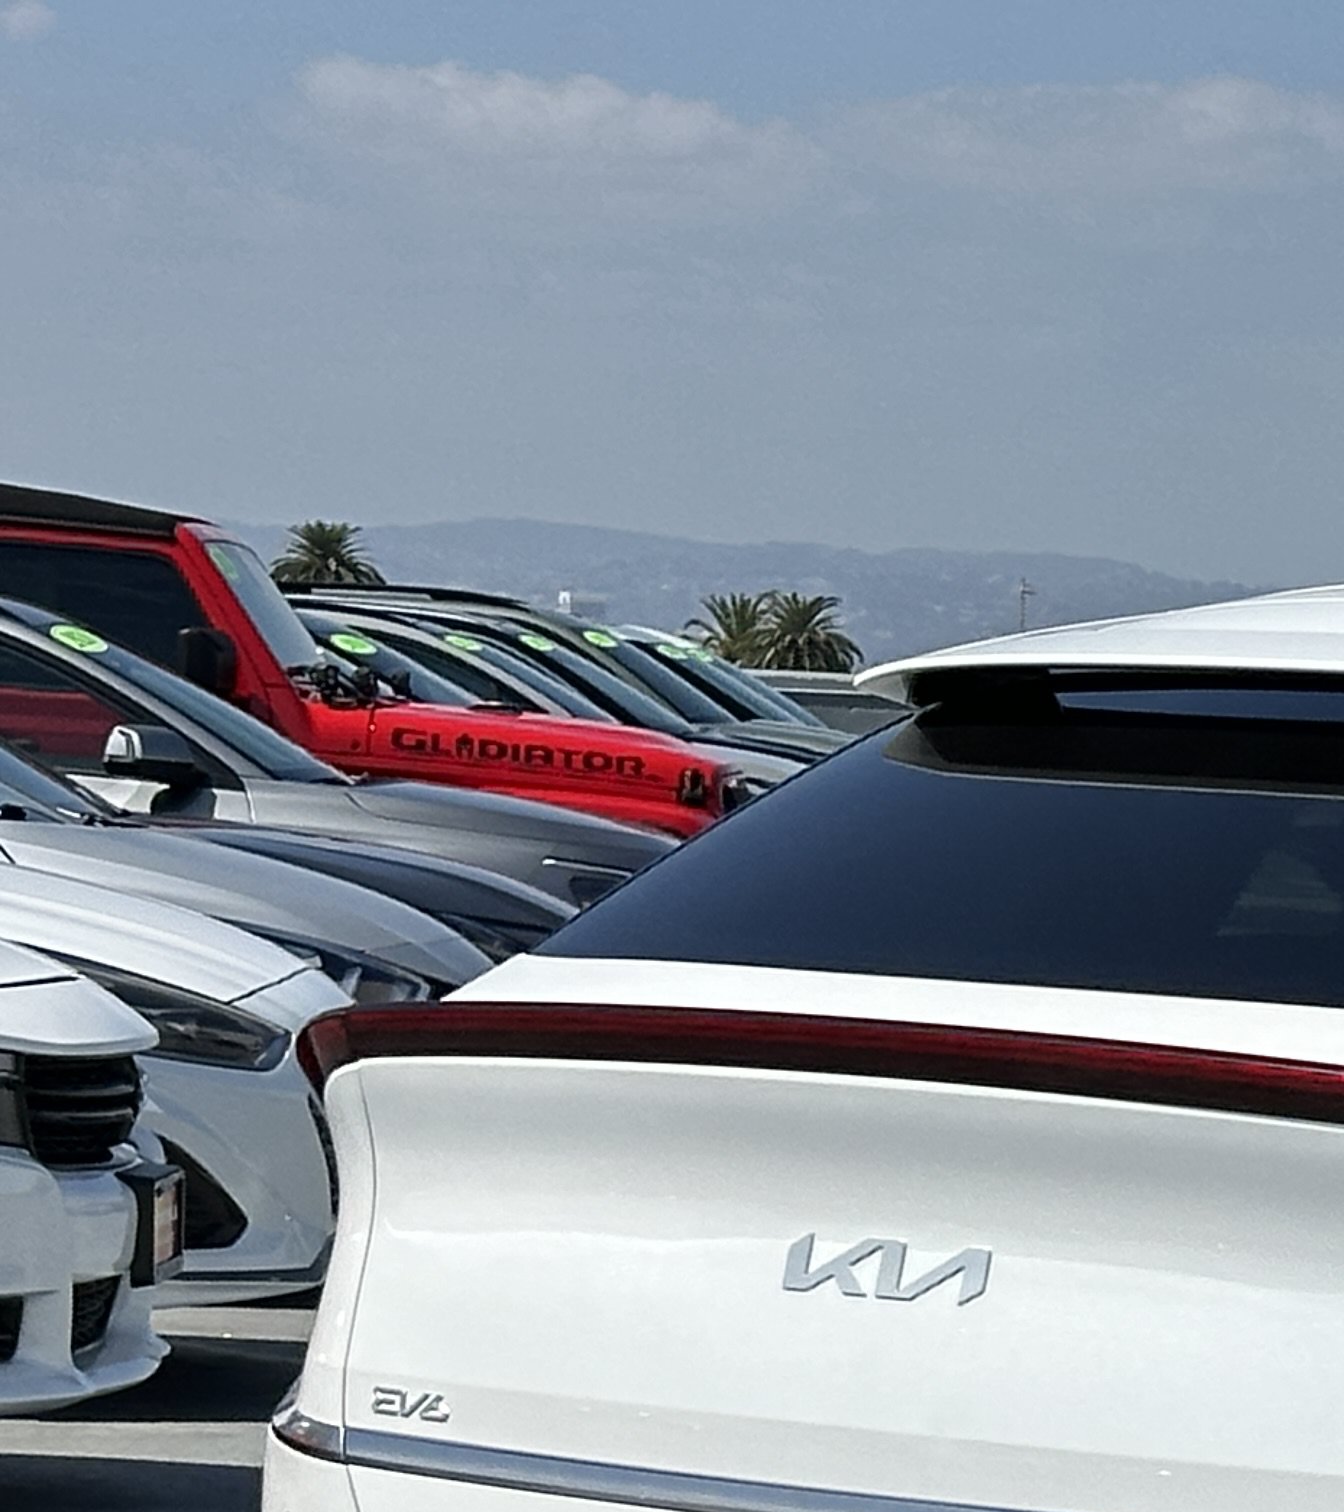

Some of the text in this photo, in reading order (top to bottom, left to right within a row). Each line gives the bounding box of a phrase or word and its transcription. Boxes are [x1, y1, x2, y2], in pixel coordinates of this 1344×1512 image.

[391, 727, 646, 777] GLADIATOR
[783, 1233, 992, 1306] KIA
[372, 1386, 451, 1423] EV6
